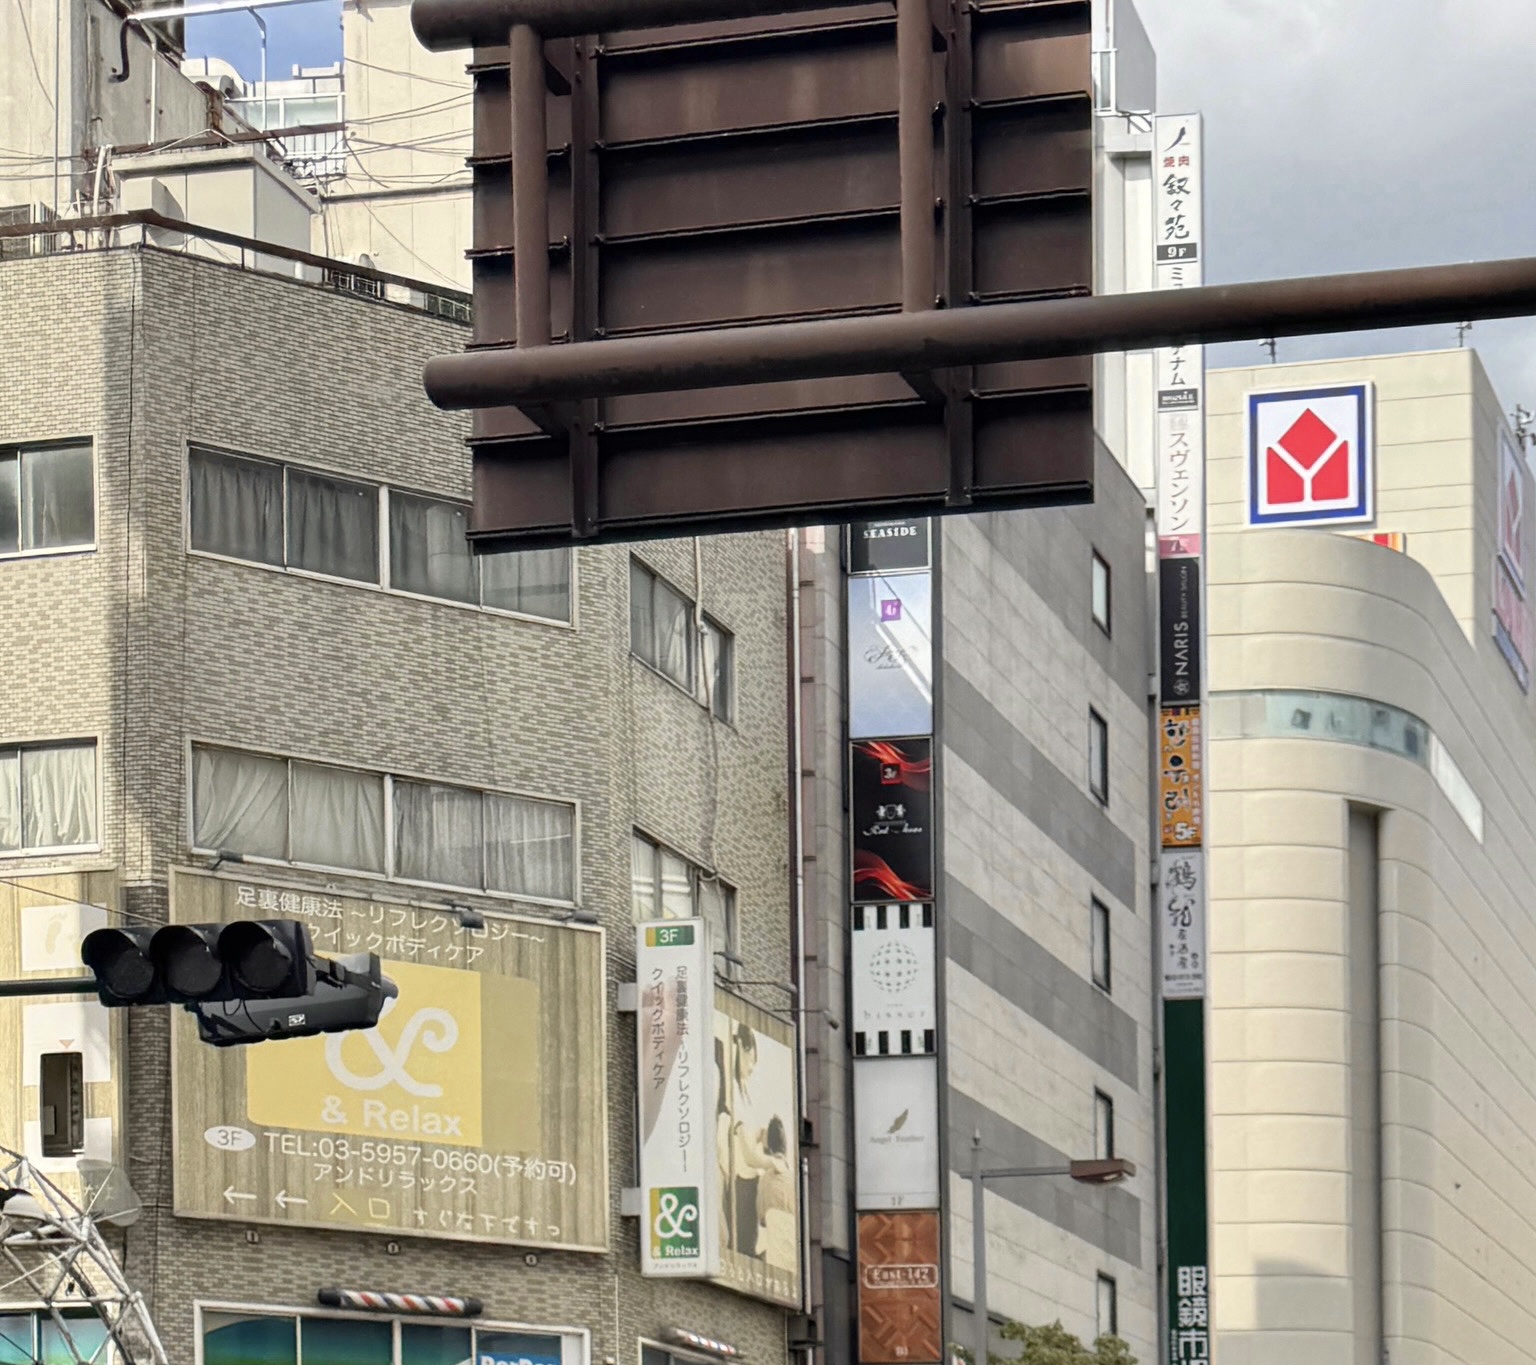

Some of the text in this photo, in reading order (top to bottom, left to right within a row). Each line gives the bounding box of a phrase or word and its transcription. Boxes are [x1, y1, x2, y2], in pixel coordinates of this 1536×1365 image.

[1169, 432, 1190, 531] スヴェンソン
[863, 526, 917, 538] SEASIDE
[1174, 621, 1189, 675] NARIS
[235, 885, 344, 920] 足裏健康法
[660, 929, 679, 943] 3F
[362, 1098, 463, 1137] Relax
[216, 1129, 243, 1147] 3F
[313, 1162, 478, 1195] アンドリラックス
[328, 1192, 391, 1220] 入口
